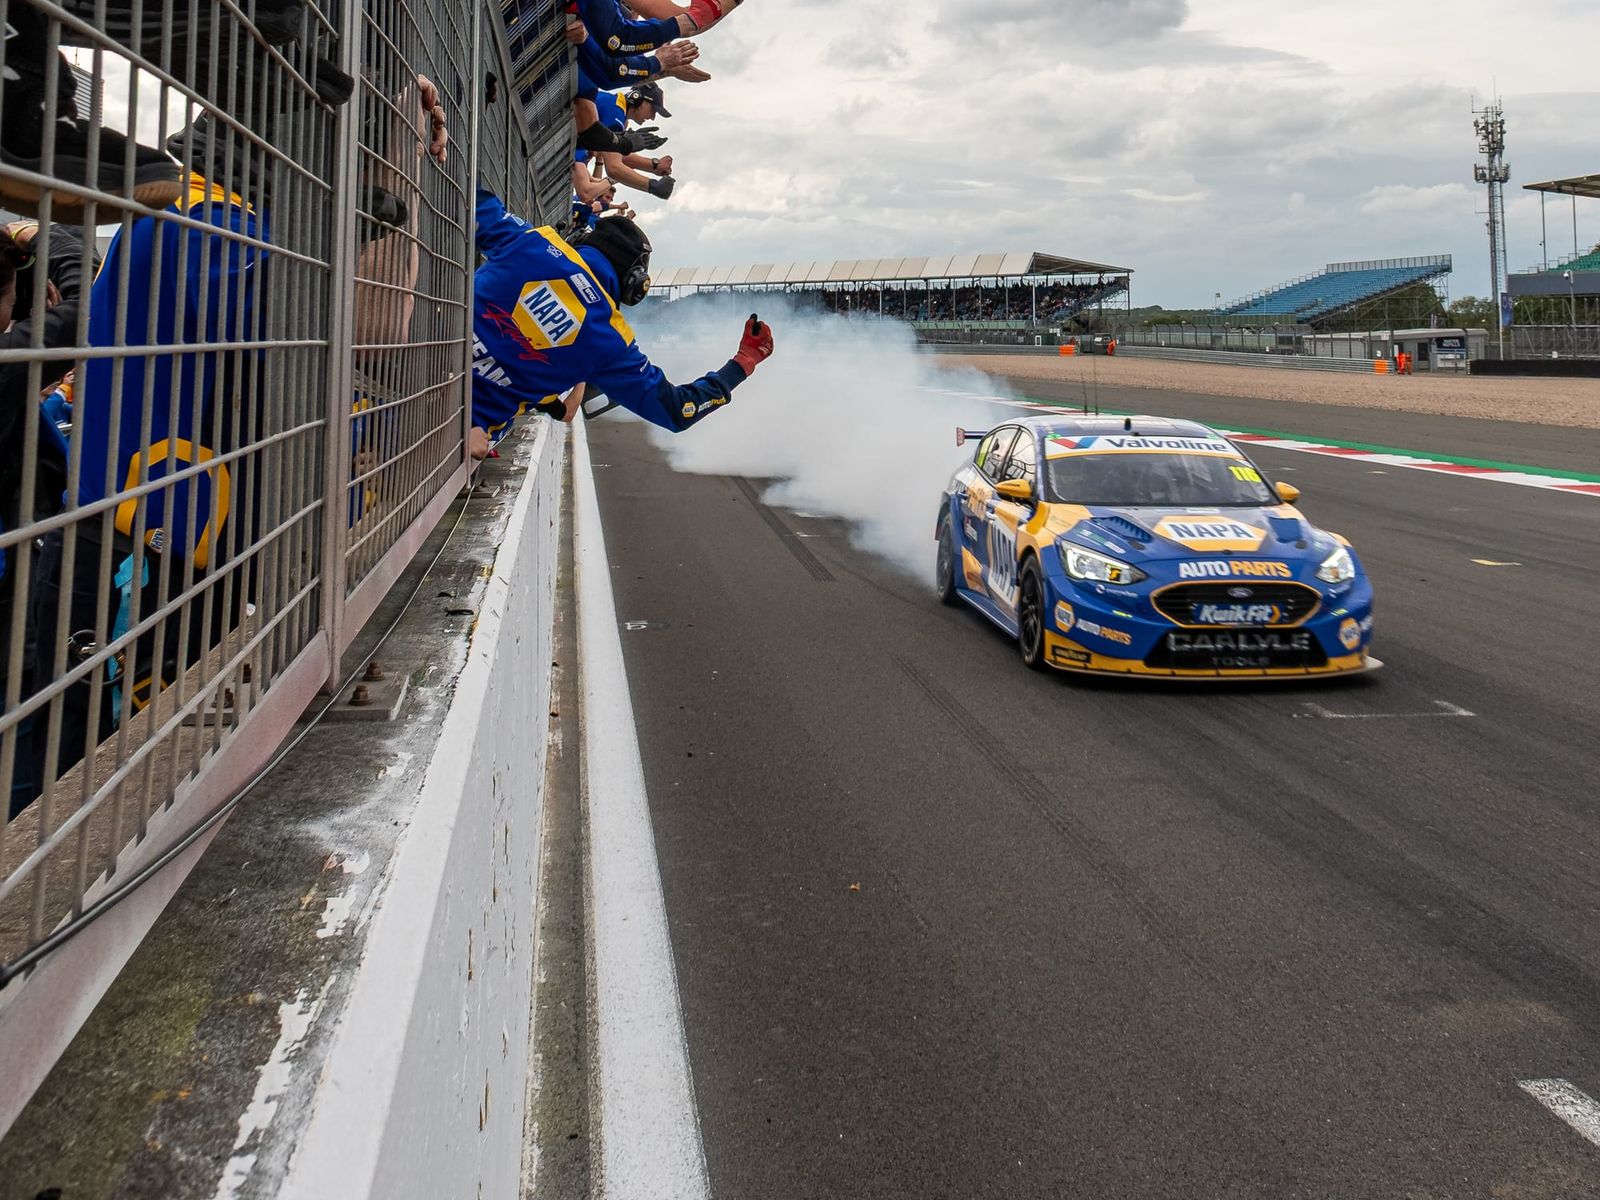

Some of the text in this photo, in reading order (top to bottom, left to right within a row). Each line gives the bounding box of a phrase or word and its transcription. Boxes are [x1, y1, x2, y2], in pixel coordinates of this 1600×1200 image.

[523, 286, 575, 342] NAPA
[1106, 438, 1228, 452] Valvoline
[1228, 465, 1262, 483] 116
[1168, 523, 1253, 538] NAPA
[1178, 560, 1293, 578] AUTO PARTS
[1168, 633, 1311, 651] CARLYLE
[1211, 657, 1271, 666] TOOLS
